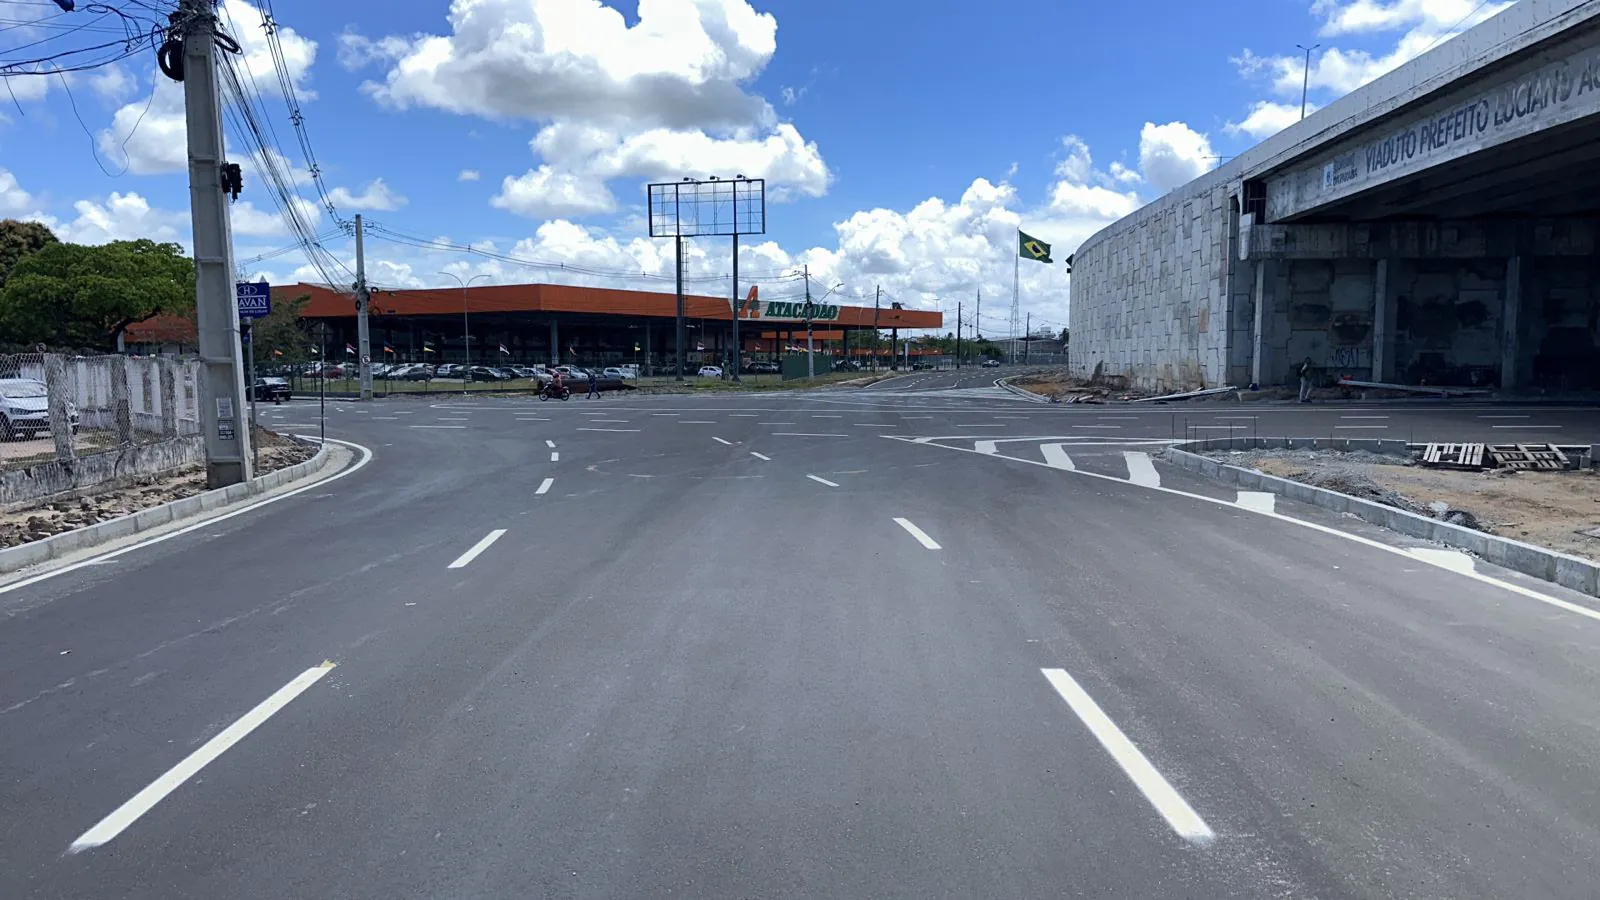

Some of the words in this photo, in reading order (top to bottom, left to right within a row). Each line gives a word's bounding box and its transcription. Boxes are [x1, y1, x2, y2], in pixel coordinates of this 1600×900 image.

[1365, 130, 1417, 173] VIADUTO
[1420, 99, 1490, 154] PREFEITO
[1494, 64, 1574, 126] LUCIANO
[238, 297, 266, 307] AVAN
